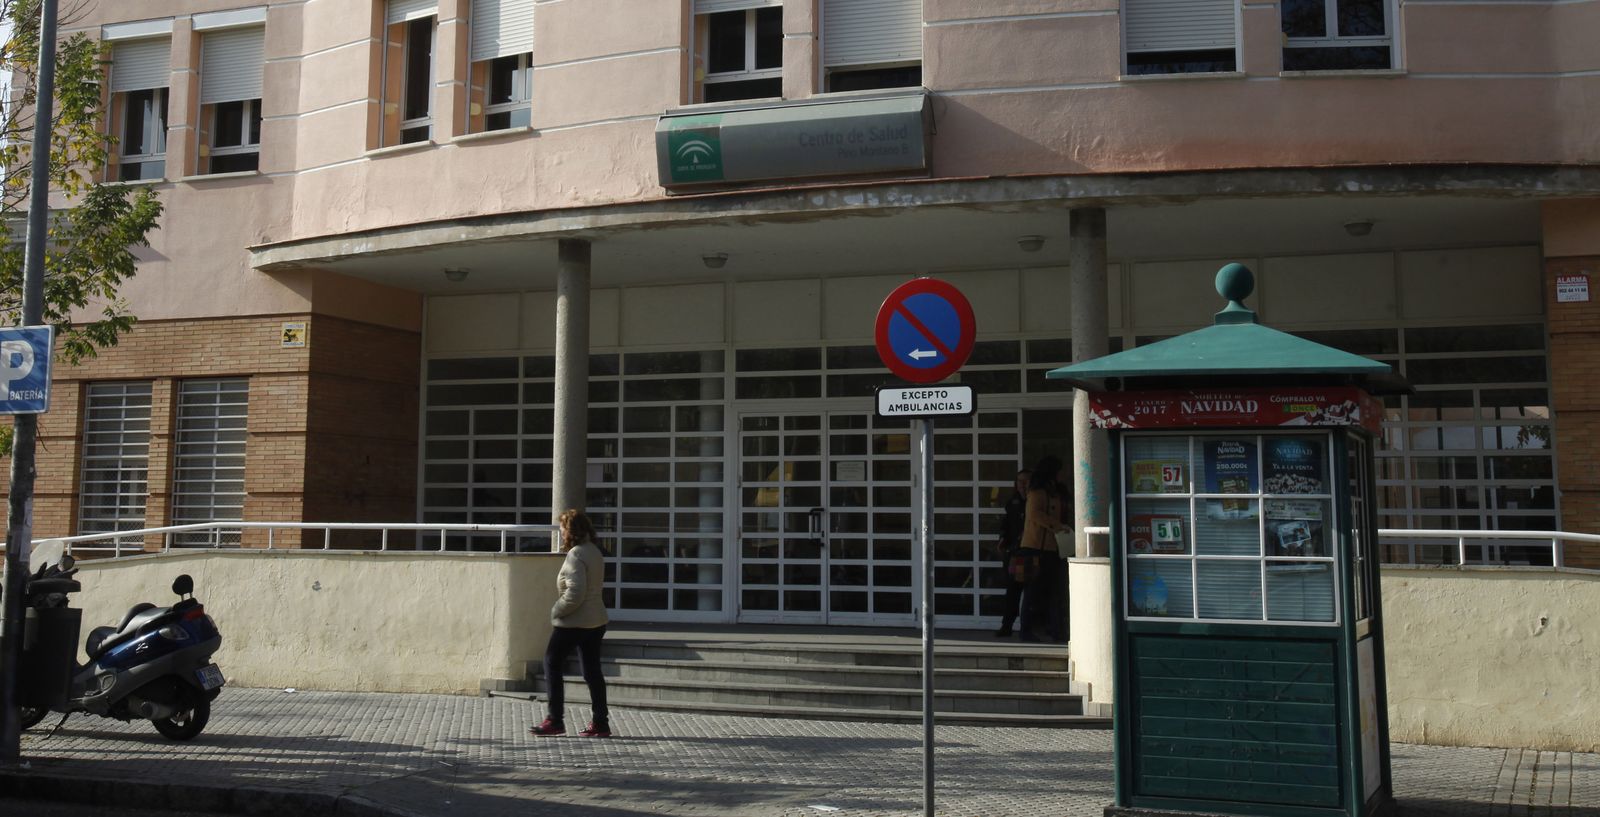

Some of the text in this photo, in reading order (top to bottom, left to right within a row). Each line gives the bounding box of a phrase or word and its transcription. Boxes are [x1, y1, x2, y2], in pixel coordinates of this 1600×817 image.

[799, 124, 907, 147] Centro de Salud
[0, 340, 34, 400] P
[9, 388, 44, 400] BATERÍA
[901, 390, 948, 400] EXCEPTO
[1270, 394, 1314, 403] CÓMPRALO
[888, 402, 963, 412] AMBULANCIAS
[1134, 405, 1167, 415] 2017
[1180, 400, 1259, 414] NAVIDAD
[1275, 447, 1313, 456] NAVIDAD
[1163, 467, 1181, 482] 57
